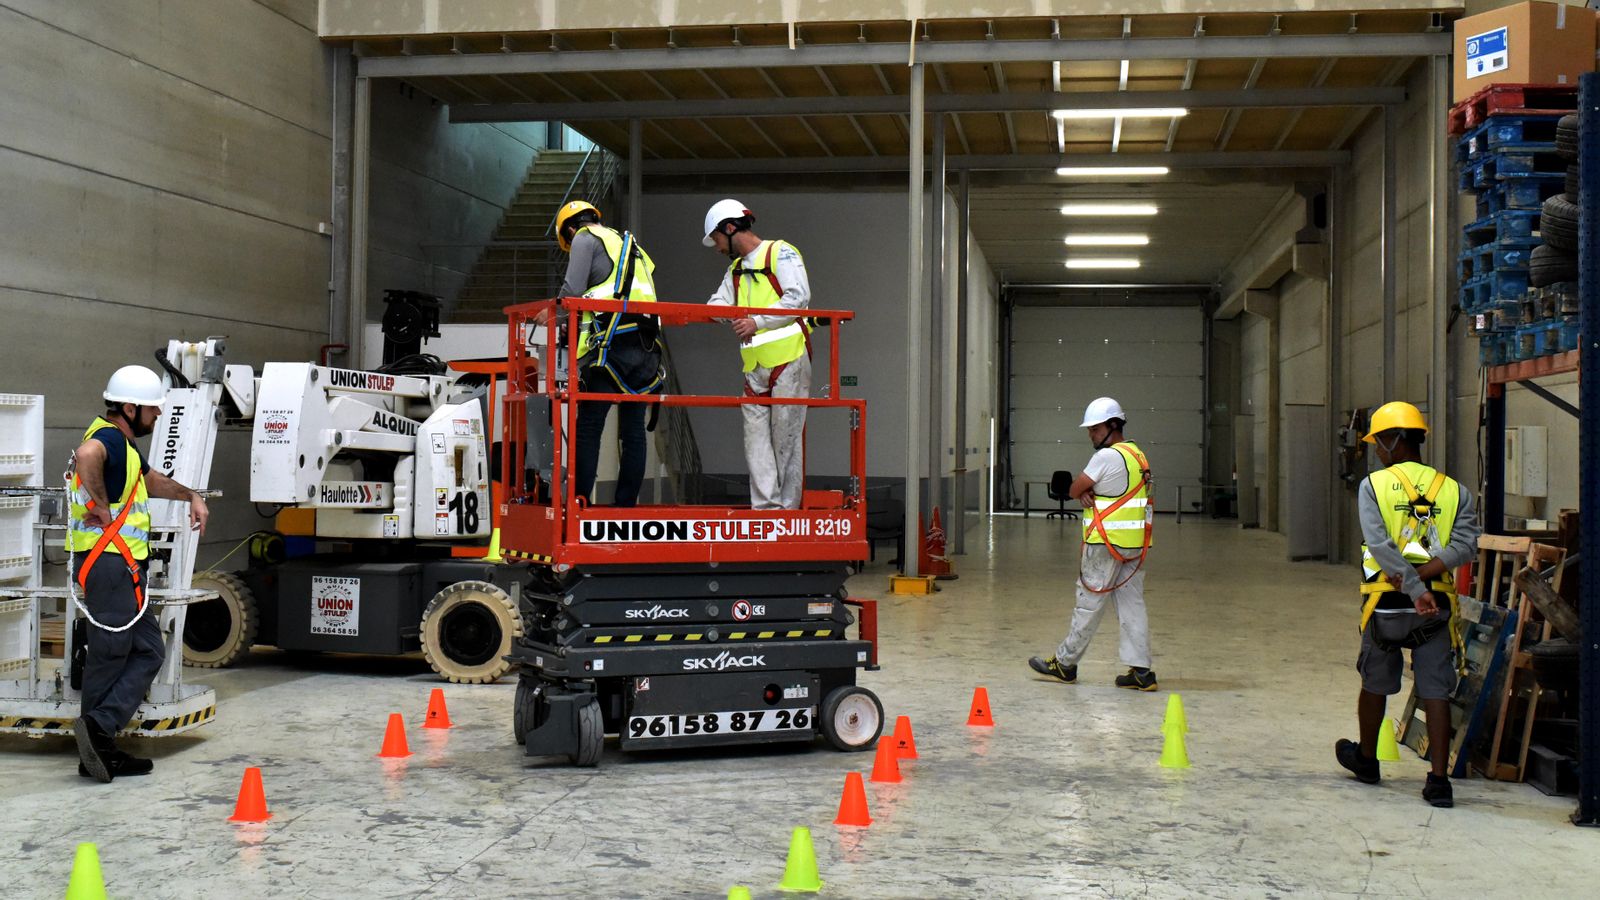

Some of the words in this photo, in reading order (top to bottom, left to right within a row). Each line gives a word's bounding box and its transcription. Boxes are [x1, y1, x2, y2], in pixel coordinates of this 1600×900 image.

[330, 370, 367, 388] UNION
[367, 375, 395, 391] STULEP
[372, 411, 420, 436] ALQUIL
[163, 406, 185, 469] Haulotte
[321, 485, 358, 503] Haulotte
[449, 491, 479, 534] 18
[583, 521, 688, 541] UNION
[692, 520, 775, 541] STULEP
[815, 518, 851, 536] 3219
[625, 604, 690, 620] SKYJACK
[683, 651, 766, 671] SKYJACK
[730, 711, 765, 732] 87
[775, 709, 809, 730] 26
